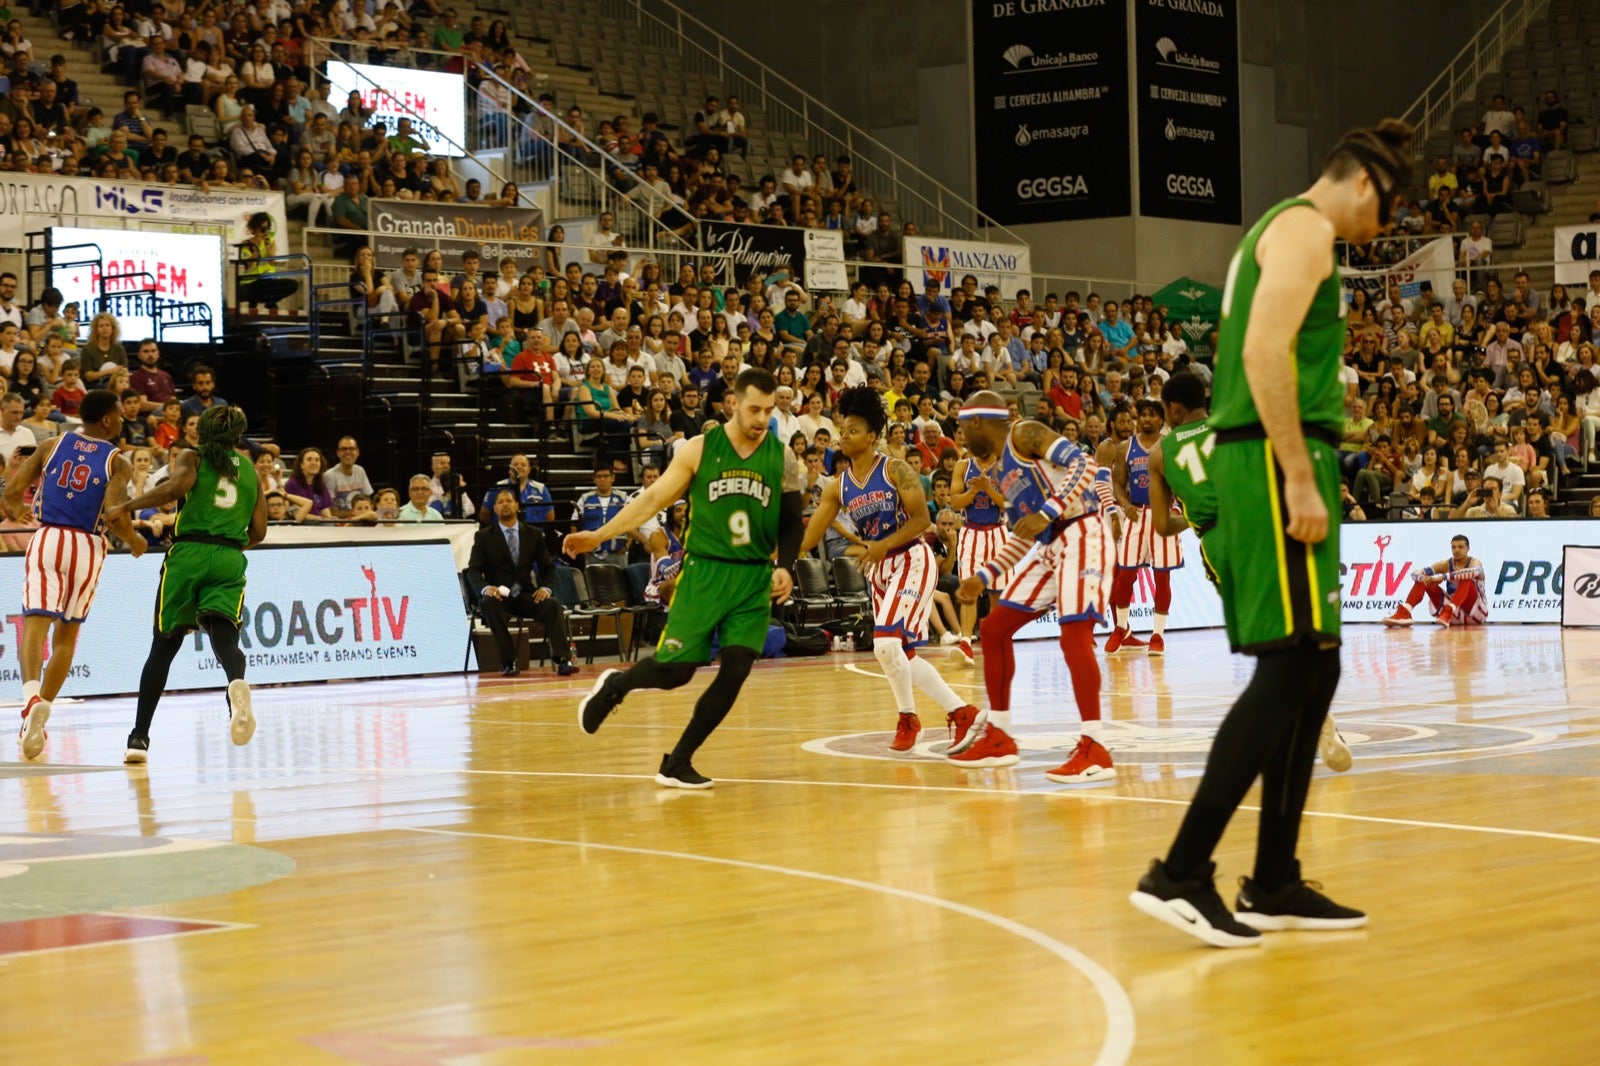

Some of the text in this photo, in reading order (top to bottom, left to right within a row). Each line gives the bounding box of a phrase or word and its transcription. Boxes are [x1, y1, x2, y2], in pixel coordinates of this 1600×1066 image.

[993, 3, 1016, 18] DE
[1031, 52, 1099, 68] Unicaja Banco
[1009, 92, 1052, 108] CERVEZAS
[1052, 87, 1101, 103] ALHAMBRA
[1161, 87, 1222, 107] CERVEZAS ALHAMBRA
[1032, 125, 1089, 140] emasagra
[1176, 127, 1215, 142] emasagra
[952, 250, 1017, 271] MANZANO
[91, 259, 187, 297] HARLEM
[74, 296, 207, 327] LOBETROTTERS
[73, 440, 98, 454] FLIP
[57, 460, 92, 492] 19
[214, 476, 238, 509] 5
[708, 477, 772, 508] GENERALS
[848, 489, 886, 512] HARLEM
[975, 495, 990, 509] 21
[728, 509, 752, 547] 9
[1492, 599, 1515, 609] LIVE
[195, 594, 410, 652] ROACTIV
[245, 650, 320, 669] ERTAINMENT
[335, 647, 374, 662] BRAND
[376, 644, 418, 659] EVENTS
